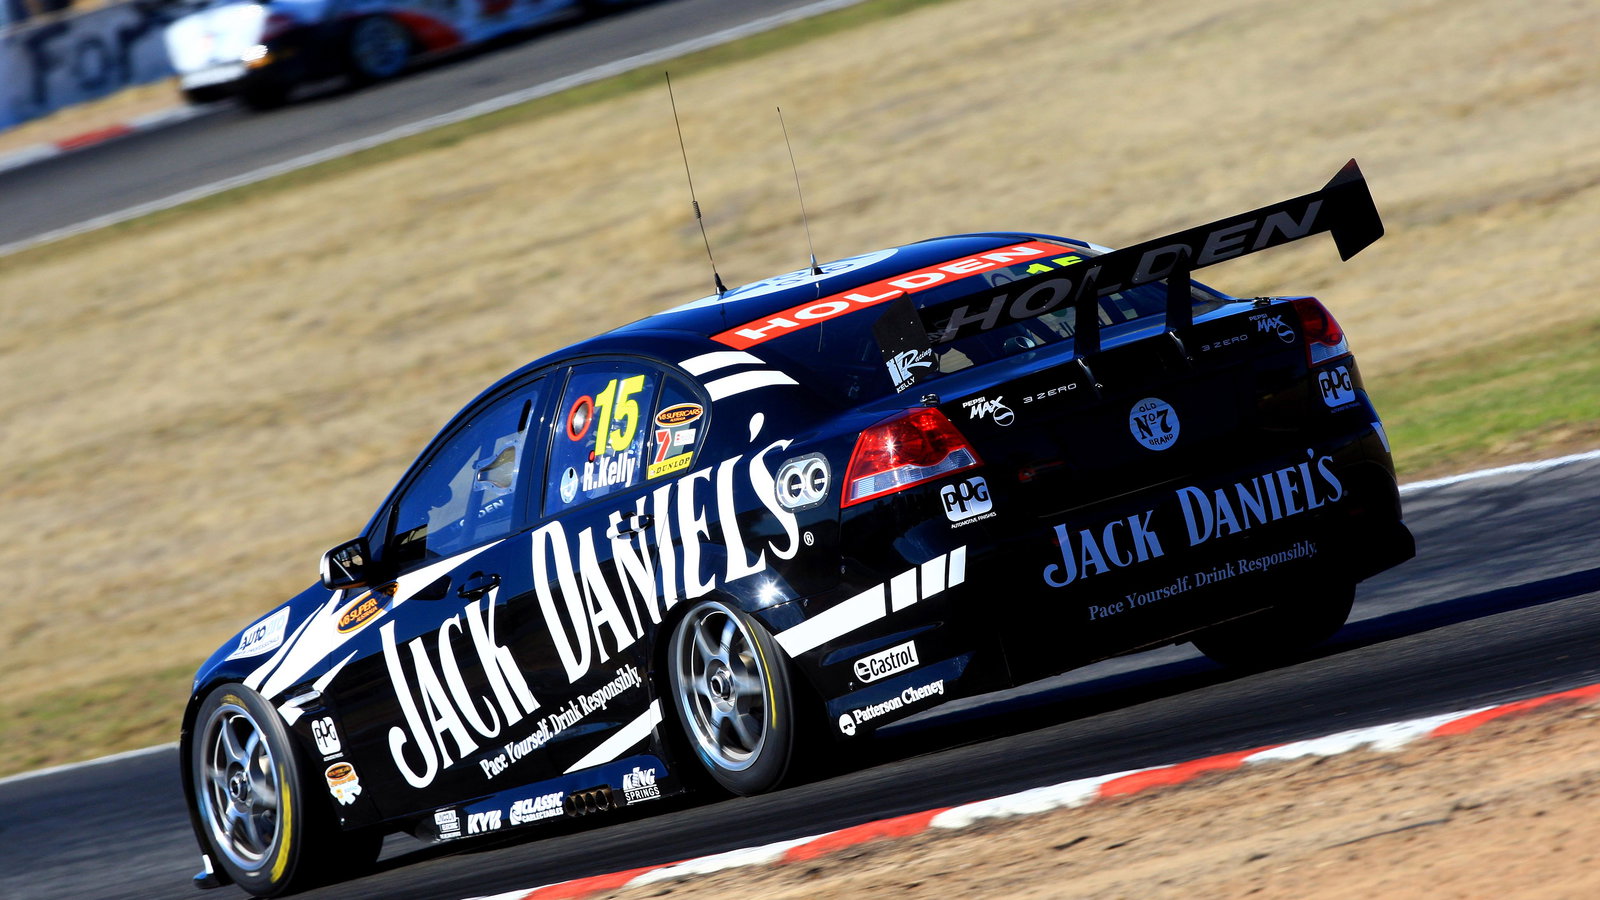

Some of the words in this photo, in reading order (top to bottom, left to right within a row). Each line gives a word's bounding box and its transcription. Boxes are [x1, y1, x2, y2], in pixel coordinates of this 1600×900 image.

[938, 199, 1324, 342] HOLDEN
[734, 246, 1045, 340] HOLDEN
[896, 376, 915, 394] KELLY
[1036, 382, 1077, 400] ZERO
[594, 375, 645, 456] 15
[962, 396, 986, 409] PEPSI
[970, 395, 1006, 420] MAX
[1138, 403, 1157, 413] OLD
[655, 457, 691, 475] DUNLOP
[943, 480, 989, 513] PPG
[1043, 509, 1165, 588] JACK
[1175, 447, 1344, 547] DANIEL'S
[1088, 601, 1124, 621] Pace
[1125, 575, 1193, 609] Yourself.
[1194, 563, 1236, 589] Drink
[1238, 539, 1318, 577] Responsibly.
[378, 585, 541, 789] JACK
[531, 412, 800, 684] DANIEL'S
[869, 645, 915, 677] Castrol
[852, 695, 904, 725] Patterson
[901, 678, 945, 705] Cheney
[479, 752, 509, 780] Pace
[504, 717, 554, 764] Yourself.
[548, 699, 584, 736] Drink
[576, 663, 643, 717] Responsibly.
[623, 766, 656, 791] KING
[624, 786, 661, 802] SPRINGS
[521, 791, 564, 814] CLASSIC
